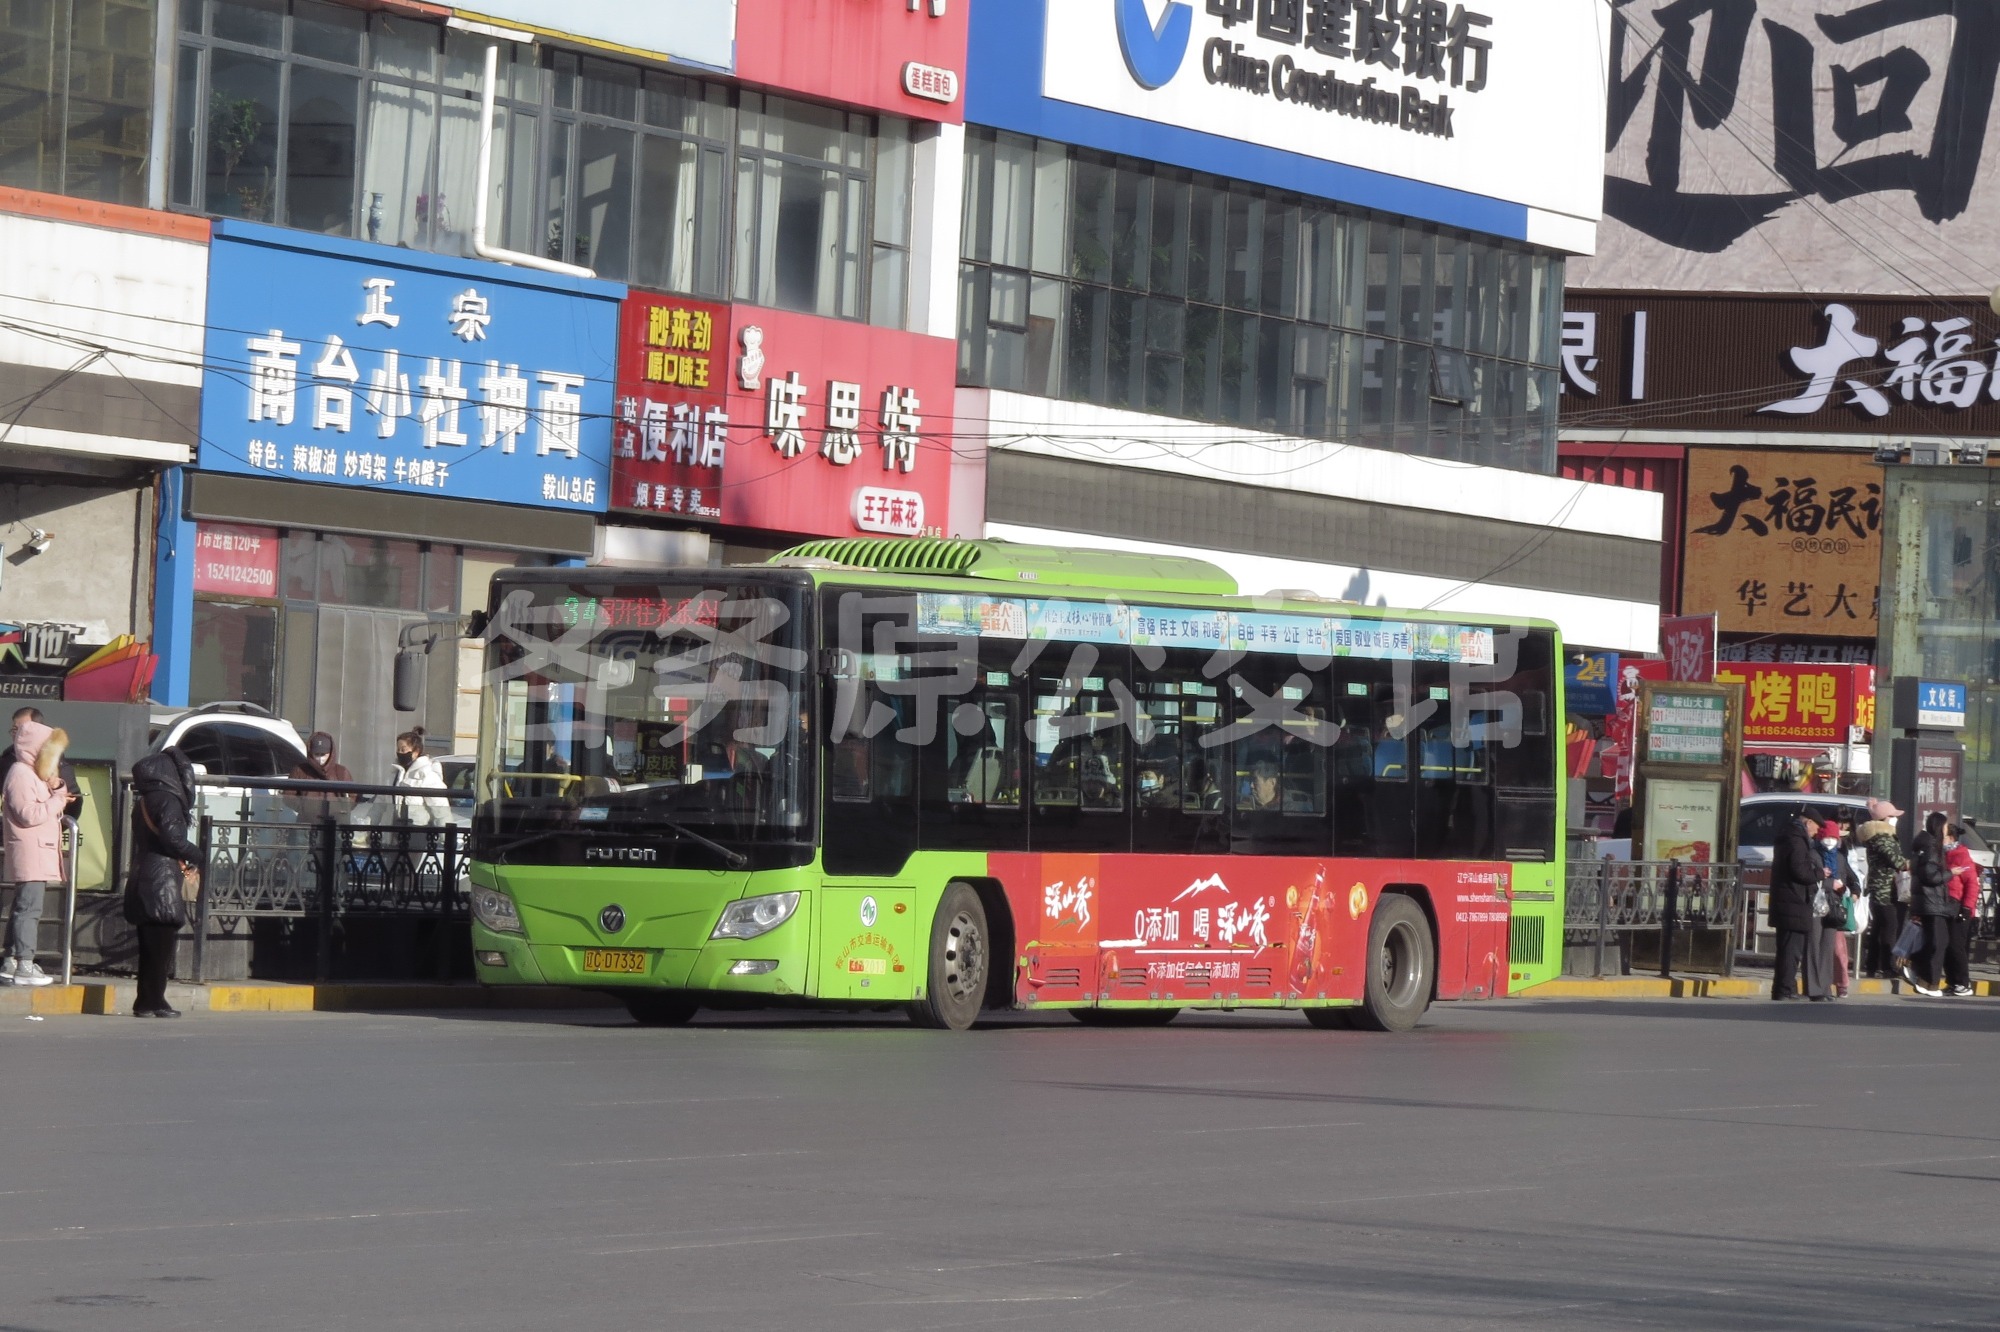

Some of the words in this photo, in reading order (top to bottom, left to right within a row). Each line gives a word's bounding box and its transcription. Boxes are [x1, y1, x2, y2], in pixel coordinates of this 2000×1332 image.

[1203, 36, 1271, 97] China
[1271, 54, 1401, 127] Construction
[1401, 85, 1456, 141] Bank
[358, 278, 491, 342] 正宗
[648, 305, 712, 352] 秒来劲
[1755, 303, 2000, 417] 大福
[247, 329, 585, 458] 南台小杜抻面
[621, 396, 637, 458] 站点
[639, 398, 729, 469] 便利店
[765, 371, 922, 475] 味思特
[344, 451, 387, 481] 炒鸡架
[393, 456, 450, 488] 牛肉腱子
[543, 473, 596, 505] 鞍山总店
[634, 482, 701, 513] 烟草专卖
[863, 496, 918, 528] 王子麻花
[207, 562, 273, 585] 15241242500
[564, 597, 597, 626] 34
[1735, 579, 1880, 619] 华艺大
[1137, 617, 1156, 636] 富强
[1160, 618, 1178, 637] 民主
[1181, 620, 1199, 638] 文明
[1202, 621, 1220, 640] 和谐
[1237, 623, 1255, 642] 自由
[1261, 624, 1277, 643] 平等
[1283, 626, 1300, 644] 公正
[1306, 627, 1322, 645] 法治
[1336, 629, 1352, 647] 爱国
[1355, 630, 1371, 648] 敬业
[1374, 632, 1389, 649] 诚信
[1392, 633, 1409, 650] 友善
[1576, 657, 1606, 681] 24
[1672, 696, 1714, 709] 鞍山大厦
[1716, 670, 1837, 724] 烤鸭
[1928, 687, 1956, 708] 文化街
[1652, 709, 1664, 721] 101
[1743, 725, 1836, 737] 电话18624628333
[647, 755, 677, 771] 皮肤
[1917, 777, 1934, 803] 种植
[1937, 777, 1956, 803] 矫正
[585, 847, 657, 861] FOTON
[1134, 906, 1180, 942] 0添加
[1193, 907, 1210, 942] 喝
